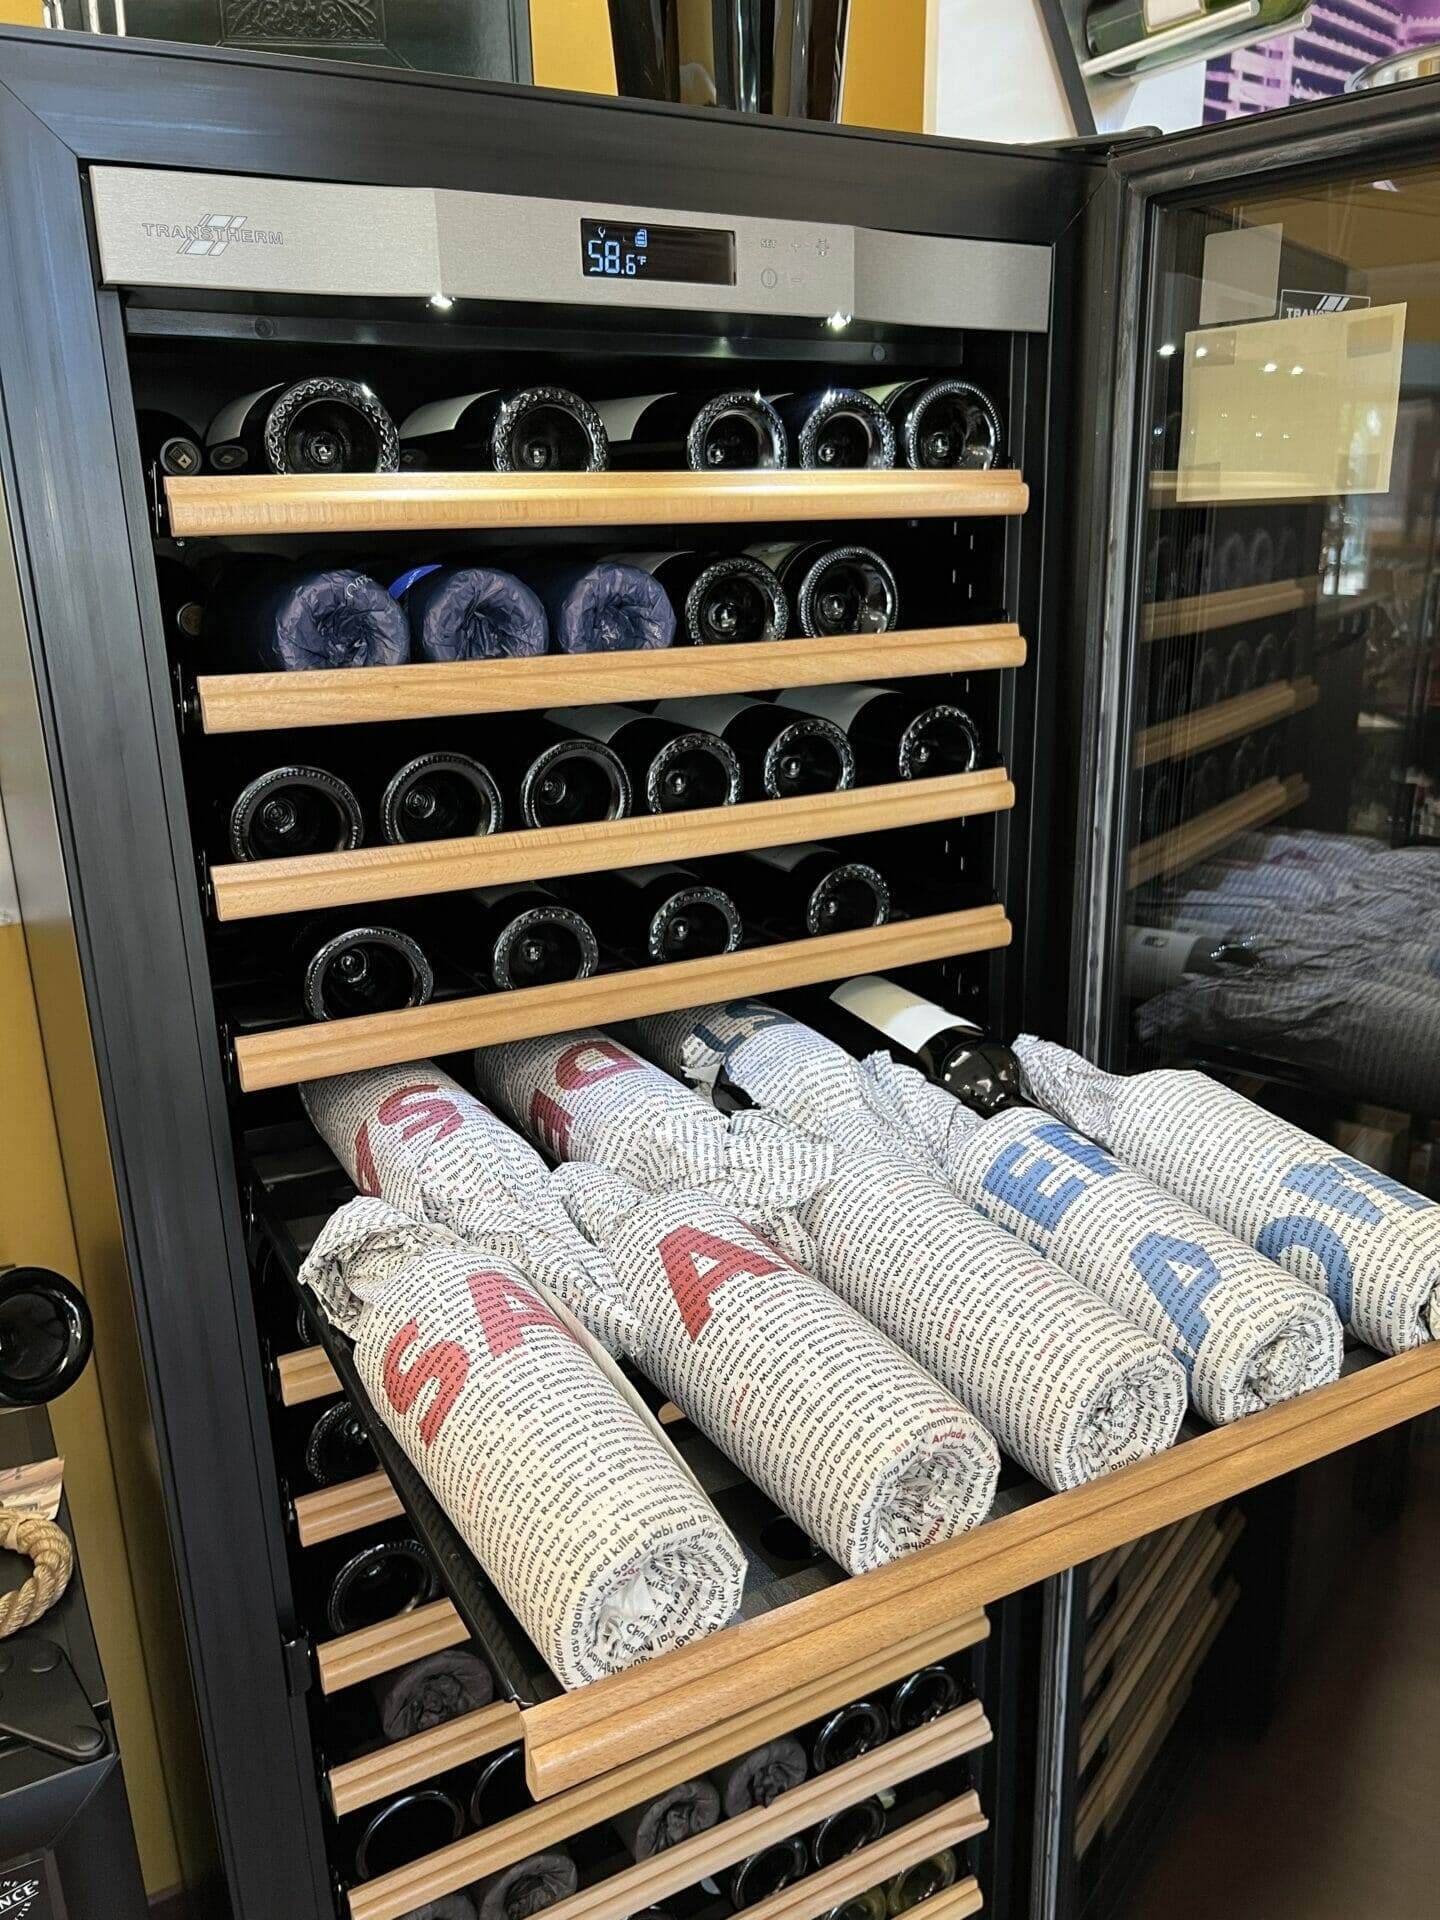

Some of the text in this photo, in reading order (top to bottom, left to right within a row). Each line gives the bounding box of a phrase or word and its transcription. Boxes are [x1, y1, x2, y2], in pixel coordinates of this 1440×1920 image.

[141, 222, 284, 245] TRANSTHERM
[943, 1248, 968, 1272] Great
[945, 1259, 987, 1306] Puerto Rico
[1098, 1244, 1129, 1288] Hurricane
[1365, 1262, 1381, 1285] Rico
[694, 1276, 767, 1348] Republic of Congo
[745, 1281, 779, 1304] Madrid
[927, 1272, 961, 1318] Exchange
[957, 1284, 977, 1308] June
[961, 1298, 981, 1322] have
[972, 1289, 1002, 1326] the first
[725, 1310, 752, 1337] study
[746, 1355, 767, 1380] June
[775, 1315, 818, 1347] Eurozone
[989, 1321, 1021, 1369] Democrat
[1002, 1349, 1016, 1367] the
[1012, 1327, 1033, 1350] only
[1008, 1308, 1067, 1383] orders for nearly
[1031, 1314, 1077, 1362] Denali July
[1038, 1318, 1091, 1375] mobile phone
[1201, 1296, 1279, 1355] while United
[1254, 1314, 1275, 1333] Rico
[741, 1342, 767, 1370] space
[757, 1348, 788, 1384] Muslim
[1047, 1333, 1091, 1384] deadline to
[1111, 1349, 1133, 1368] with
[503, 1387, 541, 1417] Roman
[745, 1347, 808, 1431] liberal challenger
[759, 1376, 795, 1429] Argentina
[804, 1354, 816, 1365] in
[770, 1407, 790, 1432] May
[783, 1375, 809, 1405] takes
[808, 1369, 817, 1378] a
[791, 1370, 871, 1466] Thomas becomes the
[796, 1364, 863, 1428] million percent
[1050, 1339, 1123, 1455] Michael President
[483, 1431, 506, 1460] May
[515, 1401, 538, 1422] ABC
[537, 1392, 553, 1405] TV
[484, 1407, 572, 1501] Donald Trump have
[807, 1409, 846, 1461] populous
[843, 1387, 868, 1410] state
[814, 1416, 853, 1480] payment in
[820, 1394, 903, 1489] and George Bush
[839, 1447, 863, 1478] prize
[860, 1415, 895, 1450] money
[892, 1403, 910, 1418] for
[519, 1448, 536, 1467] are
[530, 1469, 548, 1489] the
[539, 1443, 632, 1516] Republic of Congo
[841, 1425, 902, 1499] faster than we
[844, 1437, 911, 1533] death toll 2018
[513, 1498, 541, 1536] linked
[539, 1483, 552, 1498] to
[550, 1450, 588, 1484] former
[541, 1526, 567, 1558] buys
[562, 1482, 609, 1525] Carolina
[542, 1520, 555, 1534] to
[552, 1486, 585, 1521] equal
[582, 1469, 606, 1488] visa
[564, 1528, 598, 1568] killing
[607, 1497, 635, 1517] with
[568, 1536, 609, 1584] Maduro
[607, 1522, 622, 1537] of
[621, 1492, 678, 1524] Venezuela
[581, 1525, 641, 1589] weed killer
